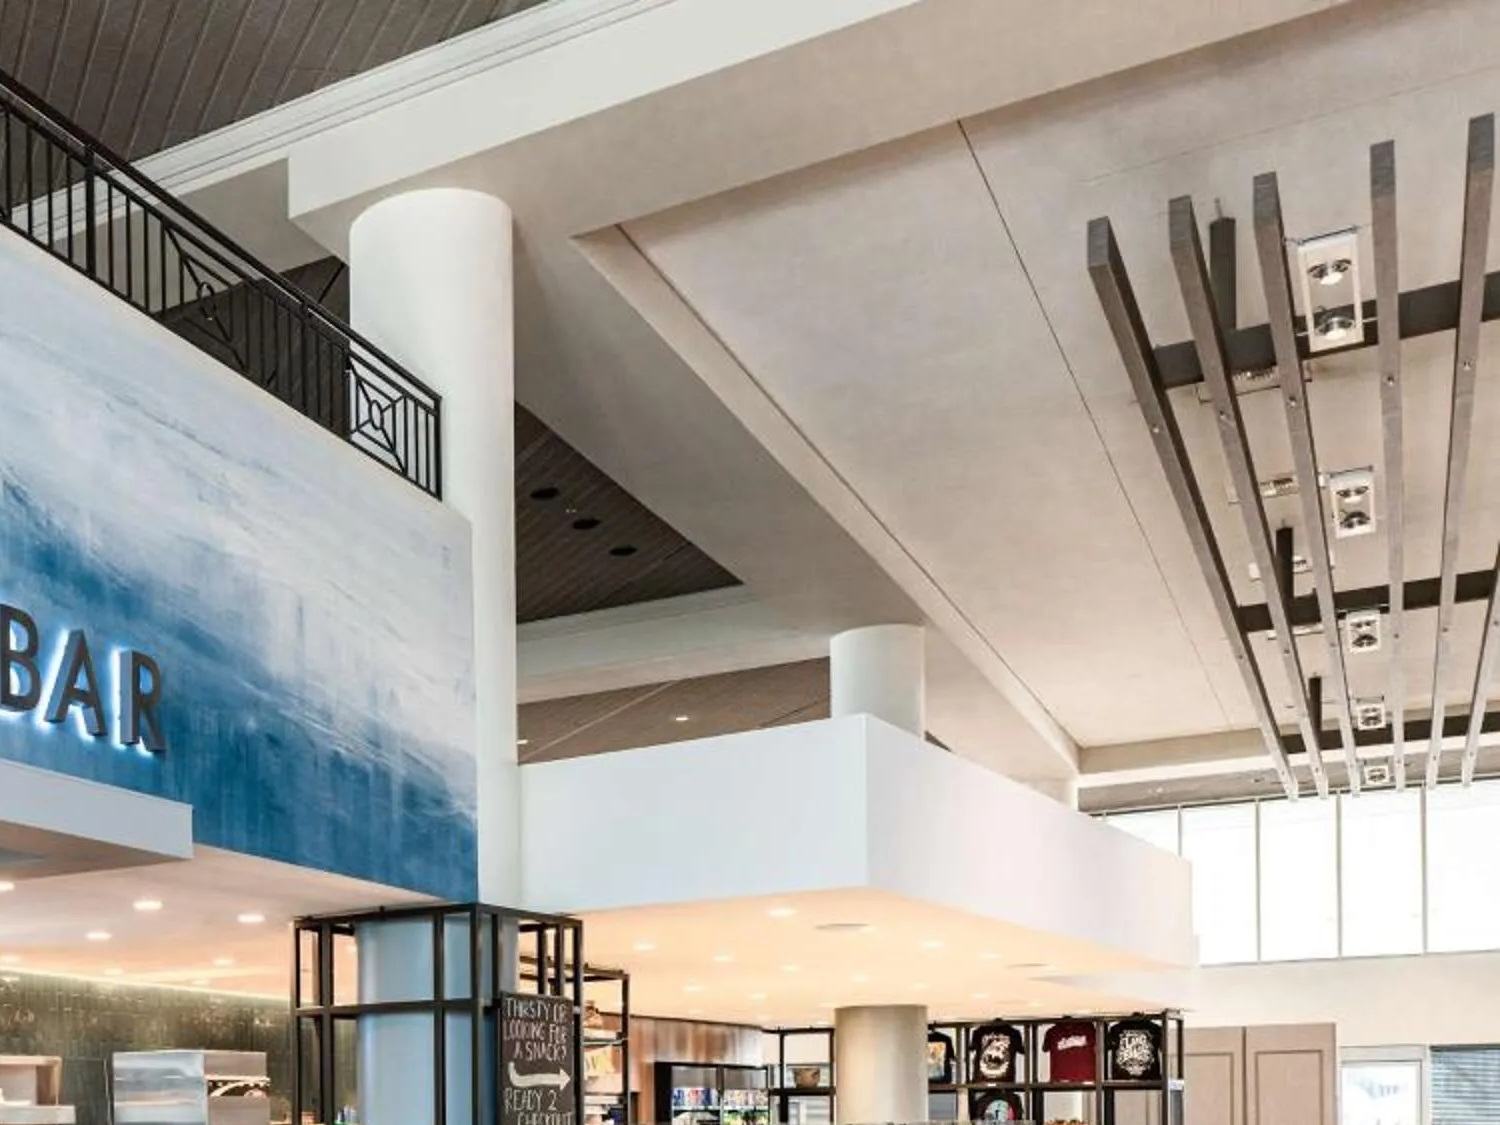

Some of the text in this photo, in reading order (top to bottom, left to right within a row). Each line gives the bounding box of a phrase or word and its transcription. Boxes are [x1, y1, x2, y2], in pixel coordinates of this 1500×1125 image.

[506, 998, 550, 1020] THIRSTY
[503, 1019, 568, 1044] LOOKING FOR
[513, 1041, 523, 1059] A
[504, 1088, 559, 1114] READY 2
